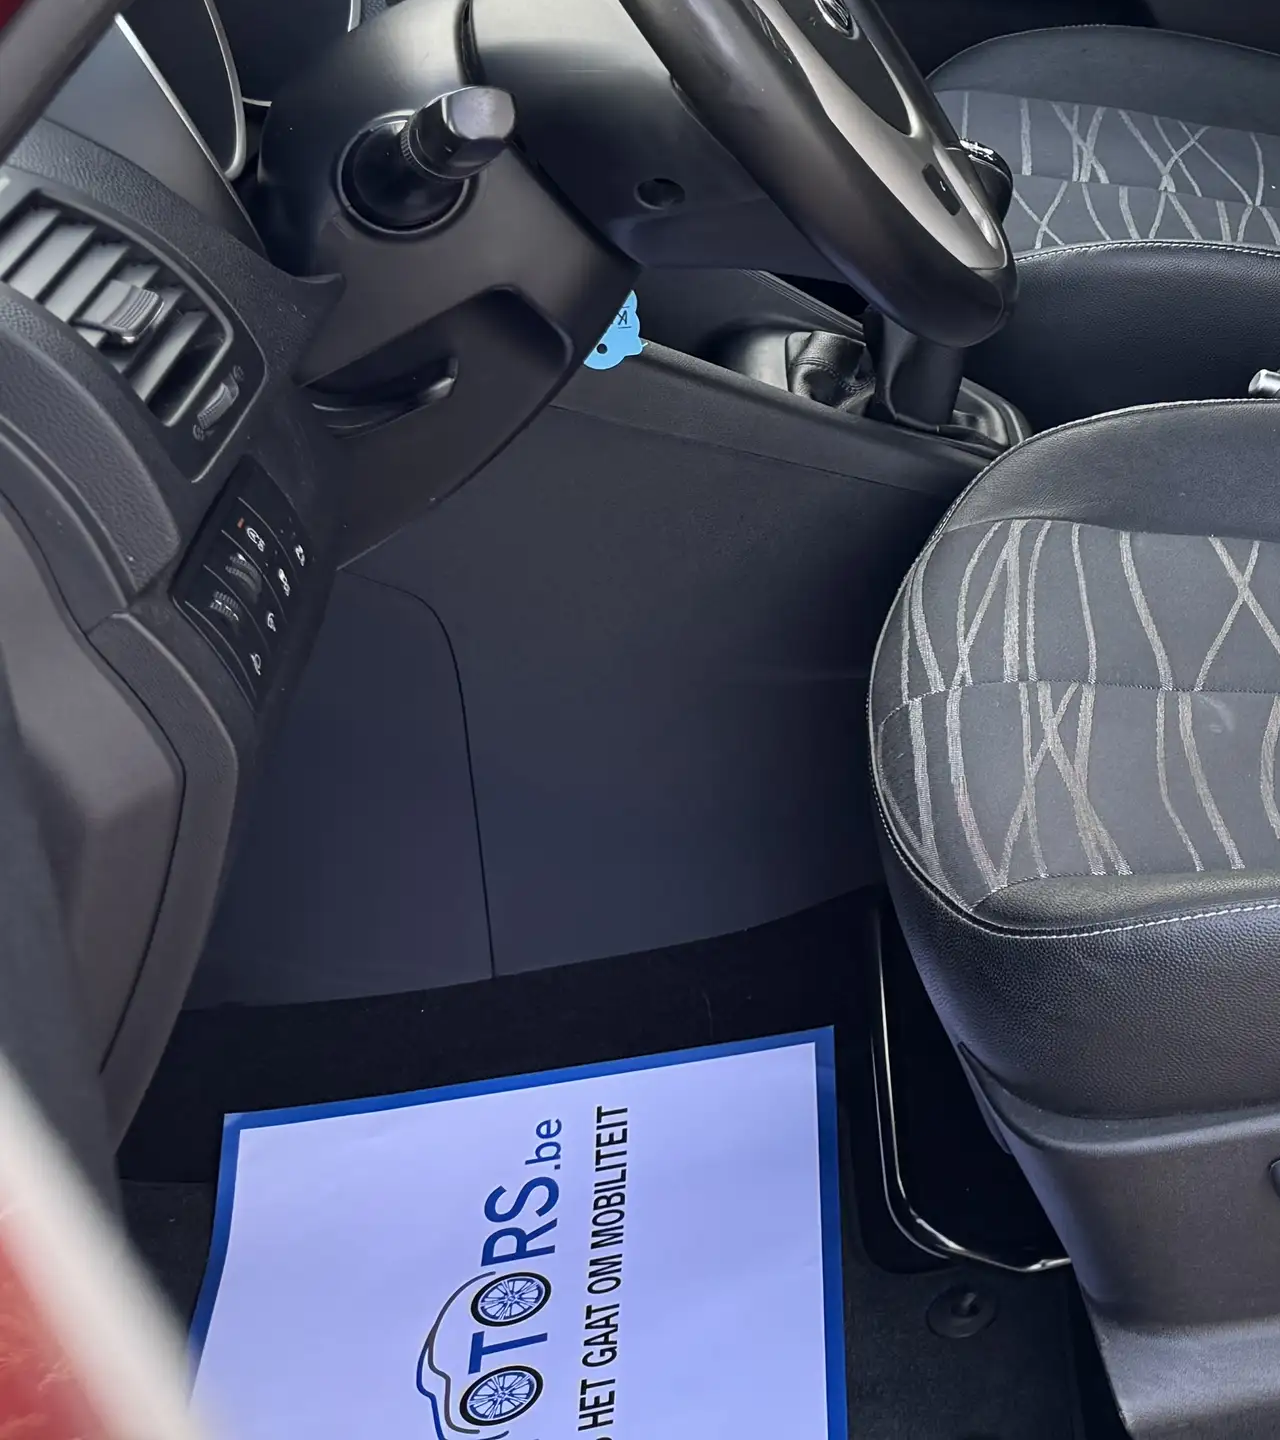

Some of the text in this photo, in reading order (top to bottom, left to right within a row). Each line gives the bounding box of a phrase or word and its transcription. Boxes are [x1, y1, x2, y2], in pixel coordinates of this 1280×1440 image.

[590, 1104, 631, 1252] MOBILITEIT
[587, 1253, 623, 1295] OM
[581, 1303, 621, 1367] GAAT
[578, 1379, 616, 1431] HET
